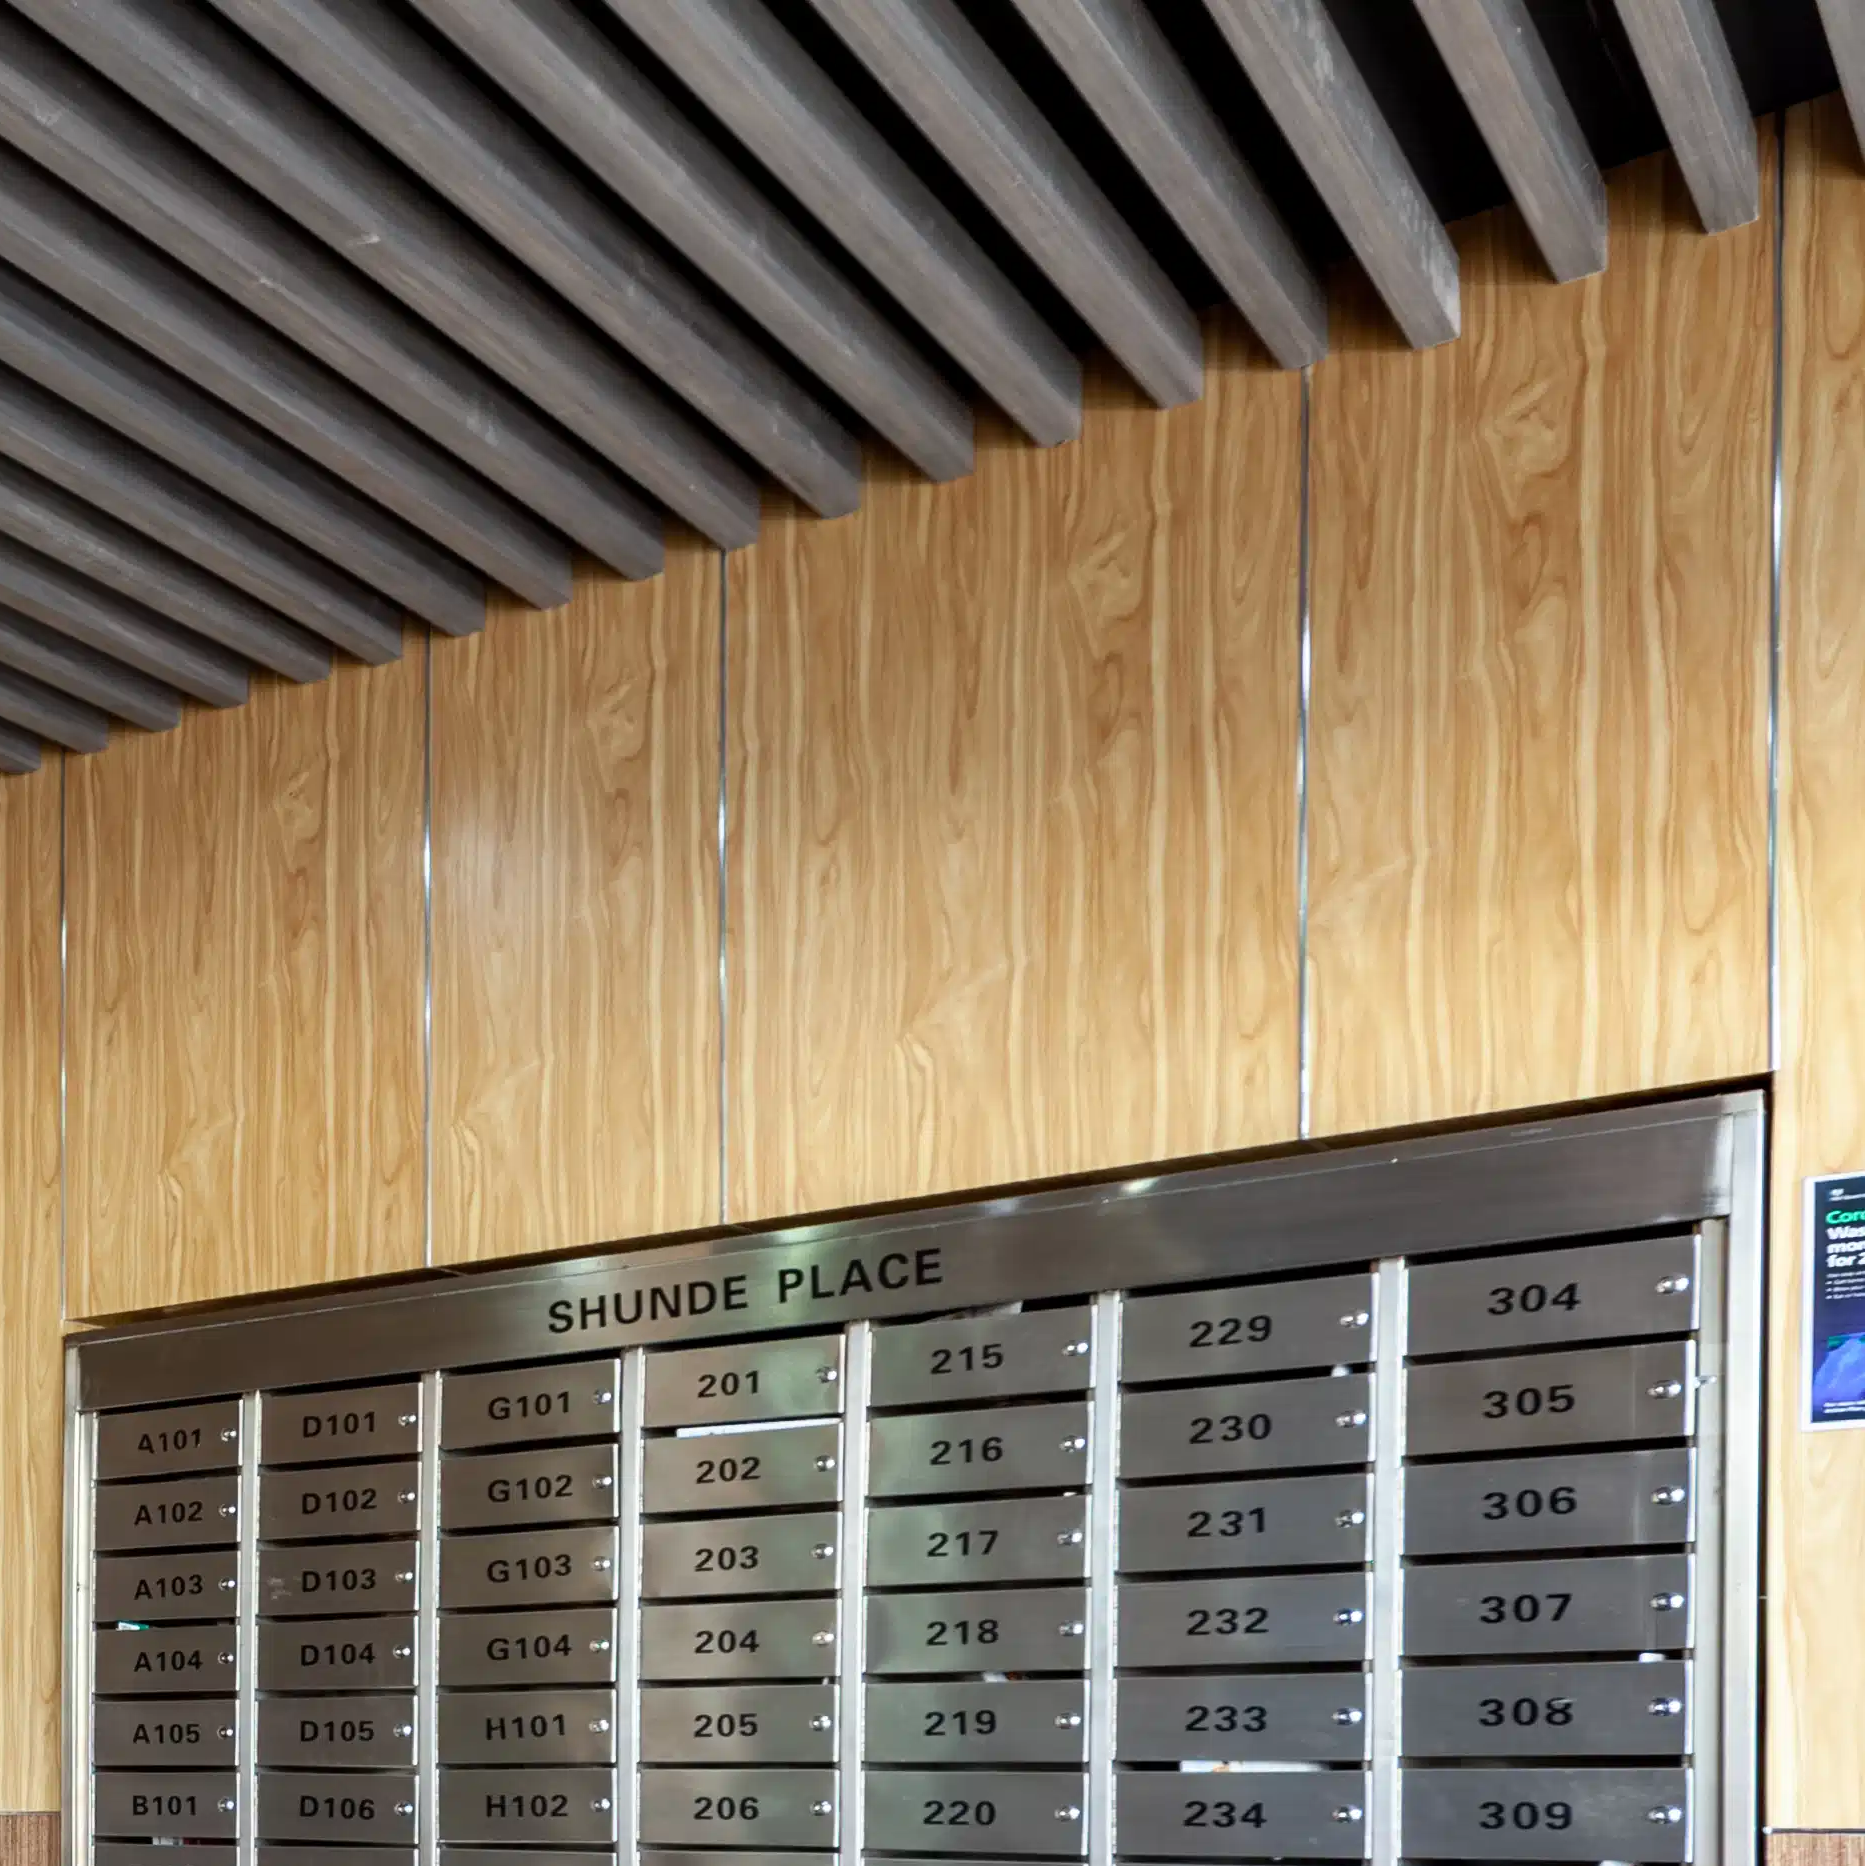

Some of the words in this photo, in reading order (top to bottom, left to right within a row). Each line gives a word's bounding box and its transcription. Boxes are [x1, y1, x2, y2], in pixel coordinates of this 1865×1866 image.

[549, 1275, 747, 1333] SHUNDE
[780, 1248, 942, 1302] PLACE
[1488, 1283, 1580, 1316] 304
[1189, 1315, 1272, 1348] 229
[930, 1343, 1004, 1375] 215
[697, 1370, 759, 1399] 201
[487, 1391, 569, 1421] G101
[1483, 1384, 1575, 1419] 305
[302, 1411, 375, 1439] D101
[1188, 1413, 1272, 1445] 230
[137, 1428, 201, 1455] A101
[930, 1436, 1003, 1466] 216
[696, 1456, 761, 1485] 202
[301, 1487, 377, 1515] D102
[487, 1474, 573, 1503] G102
[133, 1500, 203, 1526] A102
[1483, 1486, 1577, 1521] 306
[1187, 1507, 1265, 1538] 231
[927, 1529, 999, 1557] 217
[486, 1554, 571, 1584] G103
[695, 1545, 759, 1572] 203
[134, 1574, 204, 1601] A103
[301, 1568, 376, 1593] D103
[1186, 1607, 1269, 1636] 232
[1480, 1593, 1572, 1624] 307
[694, 1629, 760, 1654] 204
[926, 1618, 999, 1646] 218
[133, 1649, 204, 1673] A104
[300, 1643, 376, 1667] D104
[486, 1634, 572, 1661] G104
[694, 1712, 758, 1738] 205
[924, 1709, 997, 1737] 219
[1185, 1705, 1267, 1733] 233
[1479, 1697, 1573, 1727] 308
[132, 1723, 200, 1745] A105
[300, 1720, 374, 1743] D105
[486, 1714, 565, 1741] H101
[132, 1795, 196, 1816] B101
[299, 1795, 375, 1821] D106
[486, 1794, 568, 1818] H102
[693, 1796, 760, 1821] 206
[923, 1800, 996, 1826] 220
[1183, 1800, 1267, 1829] 234
[1479, 1801, 1572, 1830] 309
